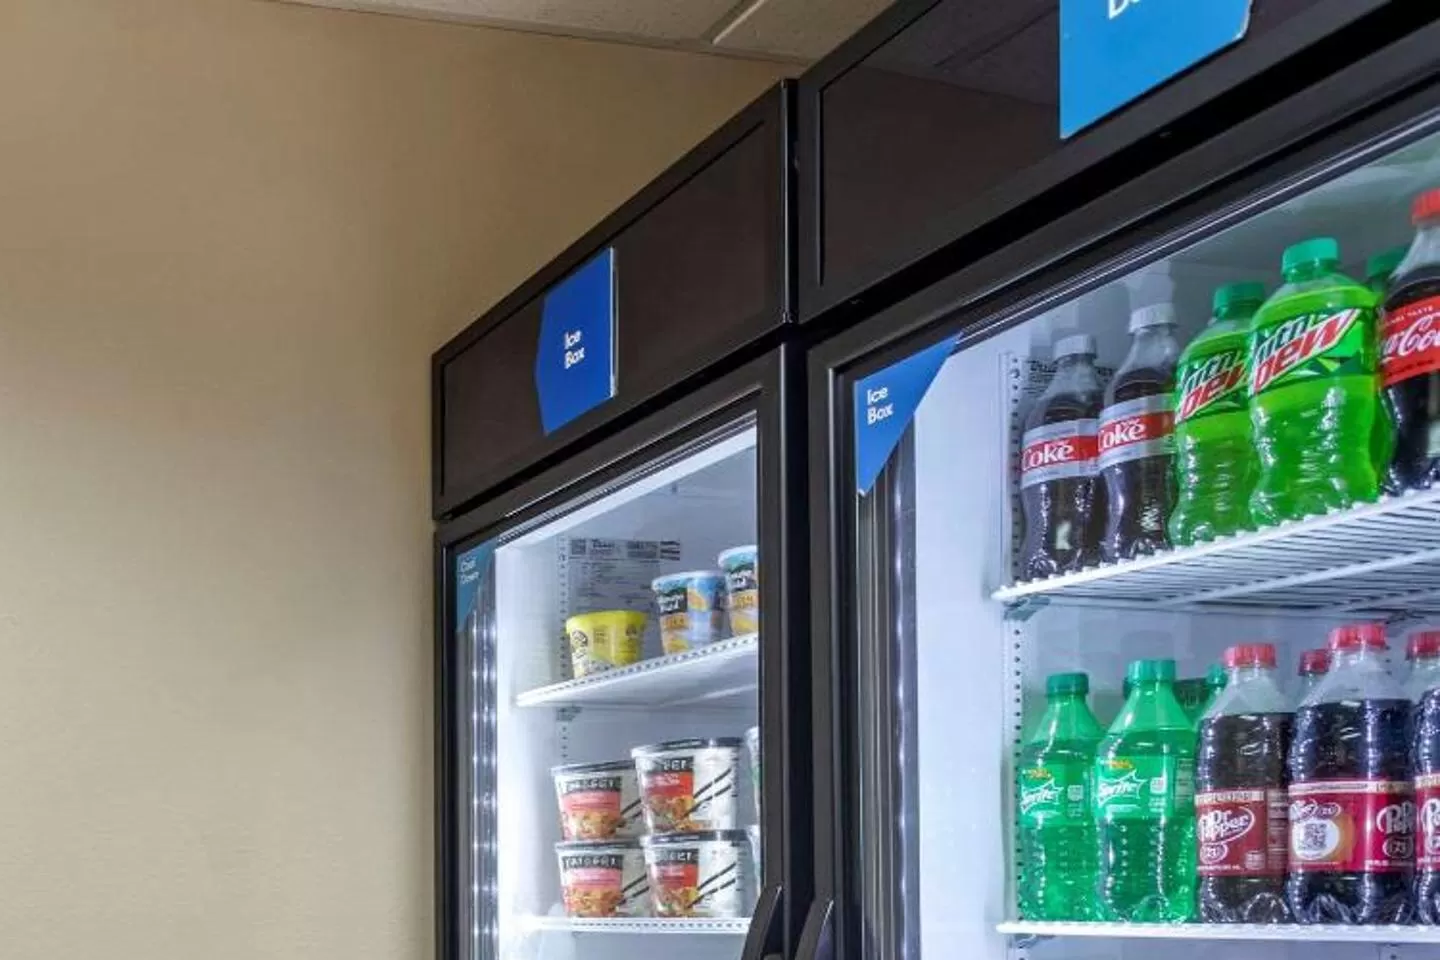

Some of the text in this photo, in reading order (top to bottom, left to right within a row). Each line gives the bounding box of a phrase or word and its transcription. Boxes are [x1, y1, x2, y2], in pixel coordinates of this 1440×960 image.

[866, 386, 889, 406] Ice
[866, 403, 894, 426] Box
[1021, 443, 1075, 472] Coke
